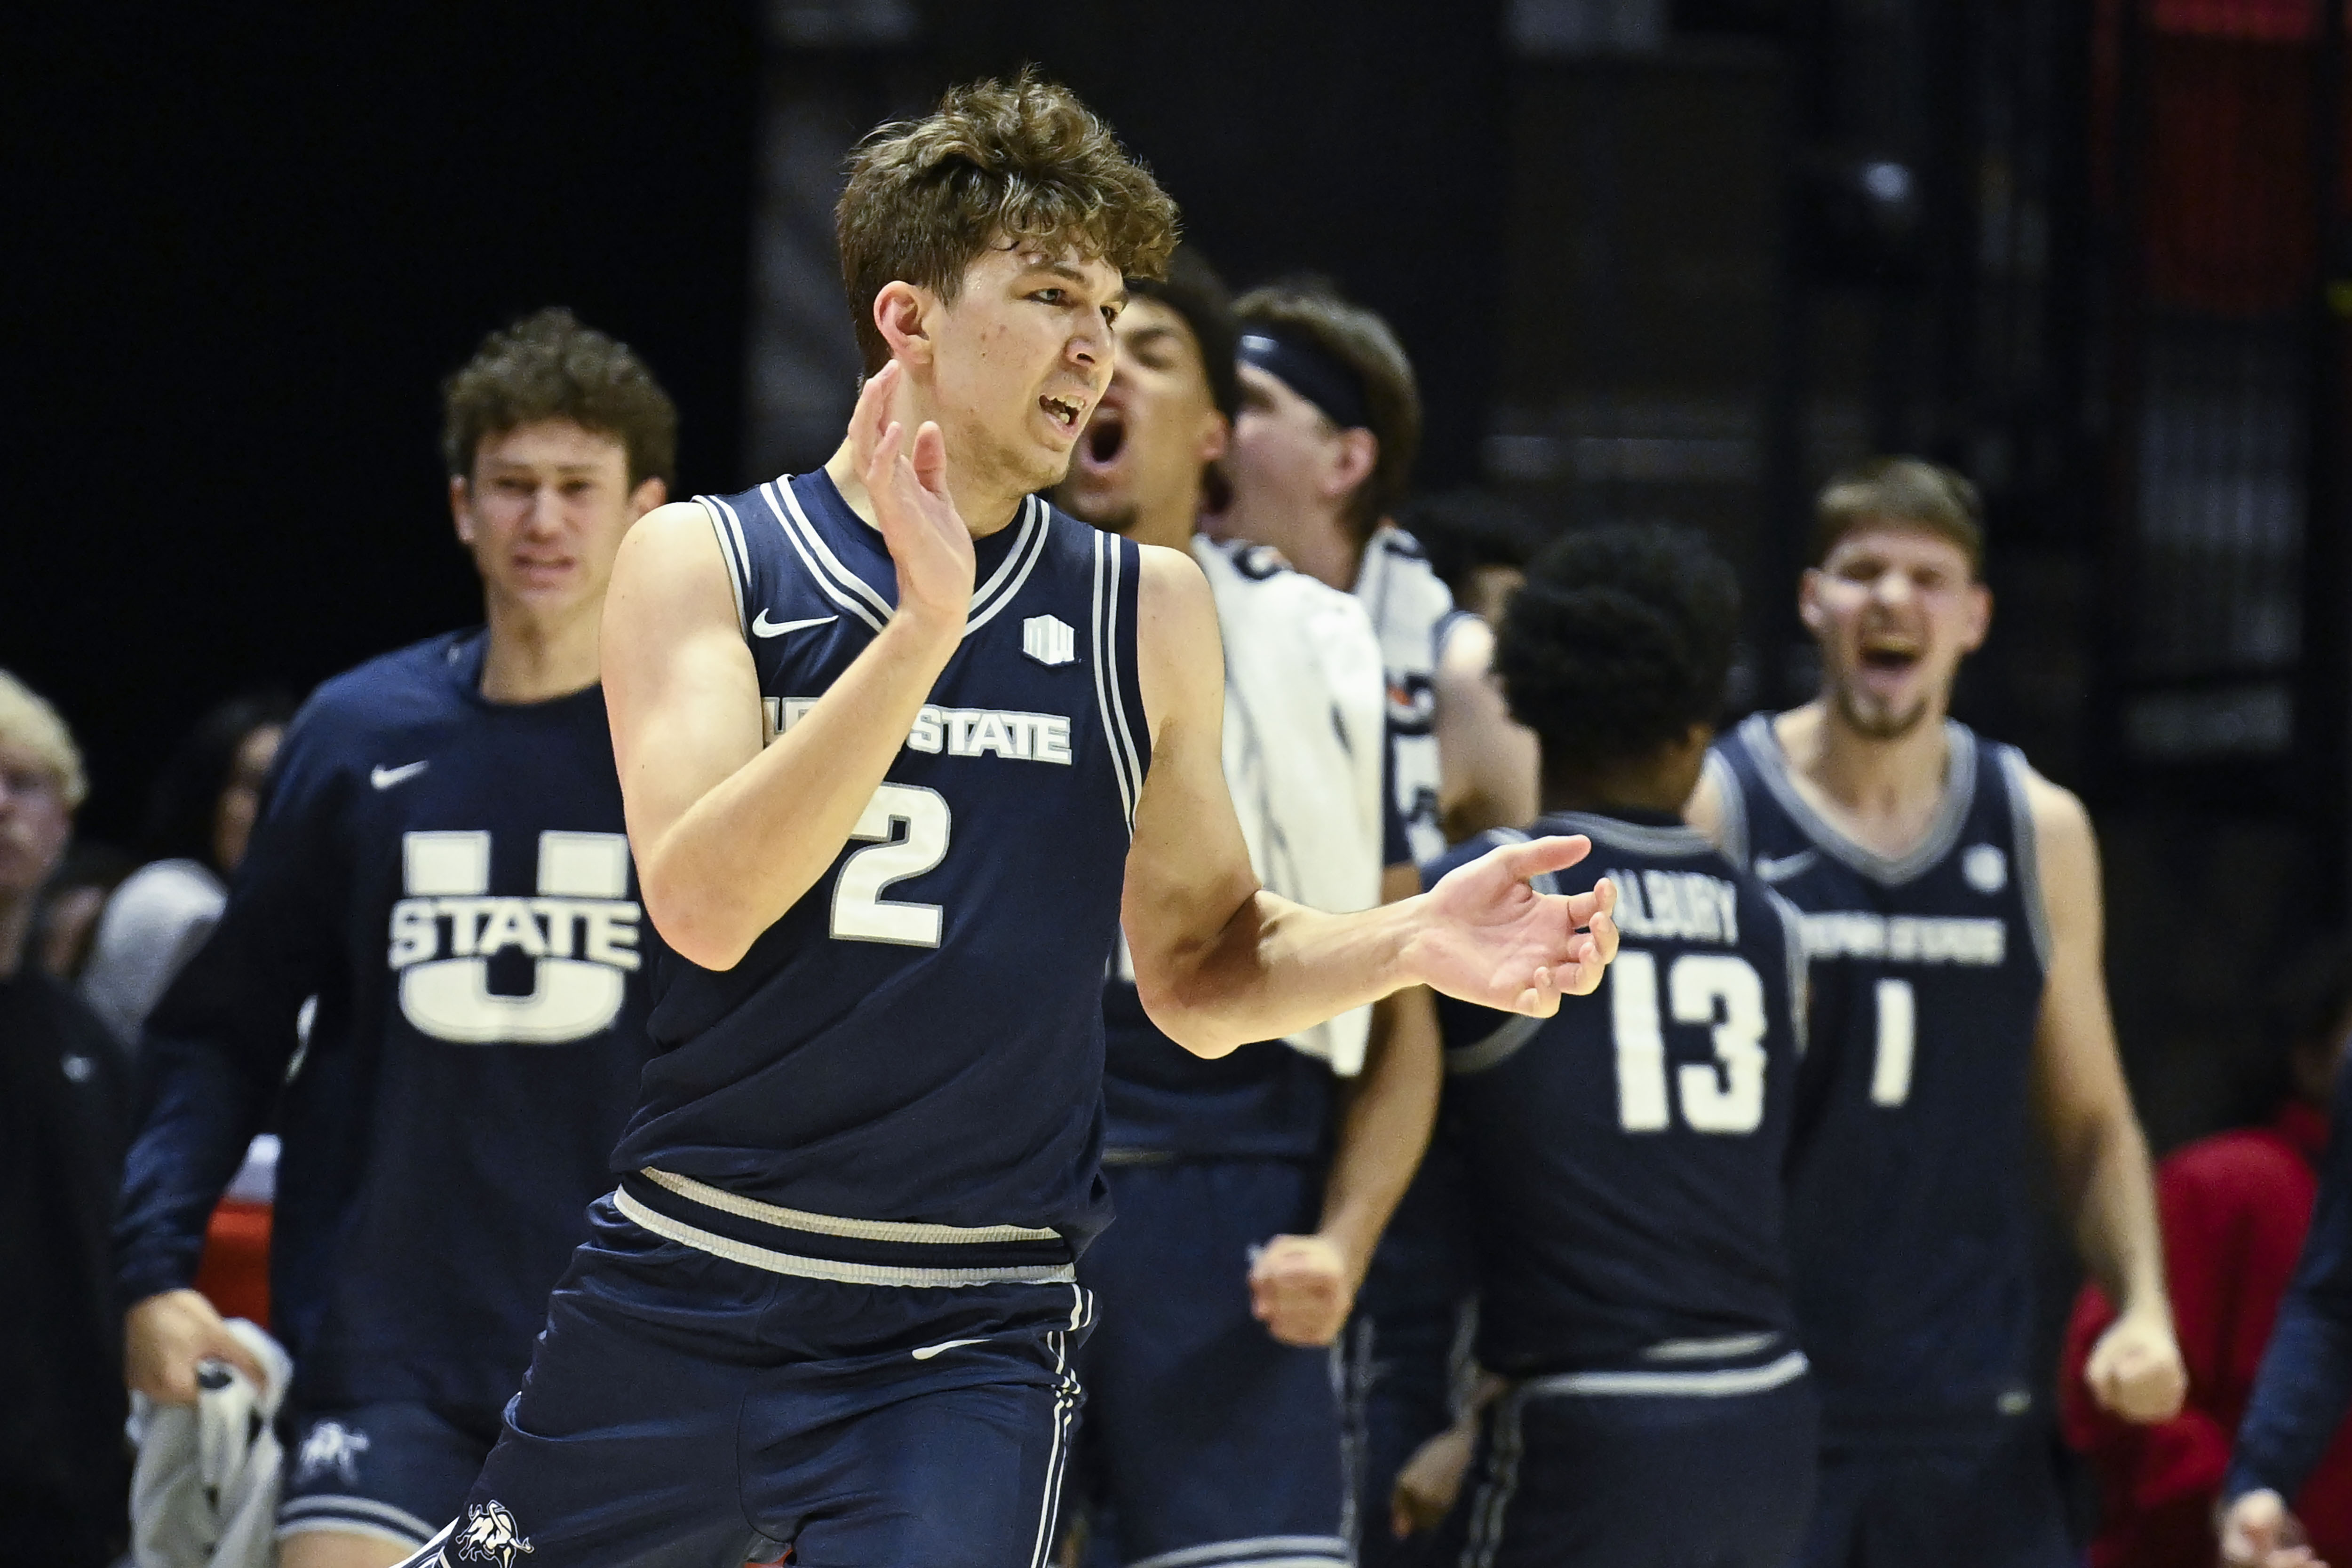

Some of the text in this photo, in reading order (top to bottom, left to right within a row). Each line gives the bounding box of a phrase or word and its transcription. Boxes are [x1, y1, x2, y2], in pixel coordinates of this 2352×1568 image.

[906, 704, 1072, 765] STATE
[829, 781, 952, 949] 2
[388, 896, 642, 971] STATE
[1610, 948, 1767, 1134] 13
[1870, 977, 1915, 1108] 1
